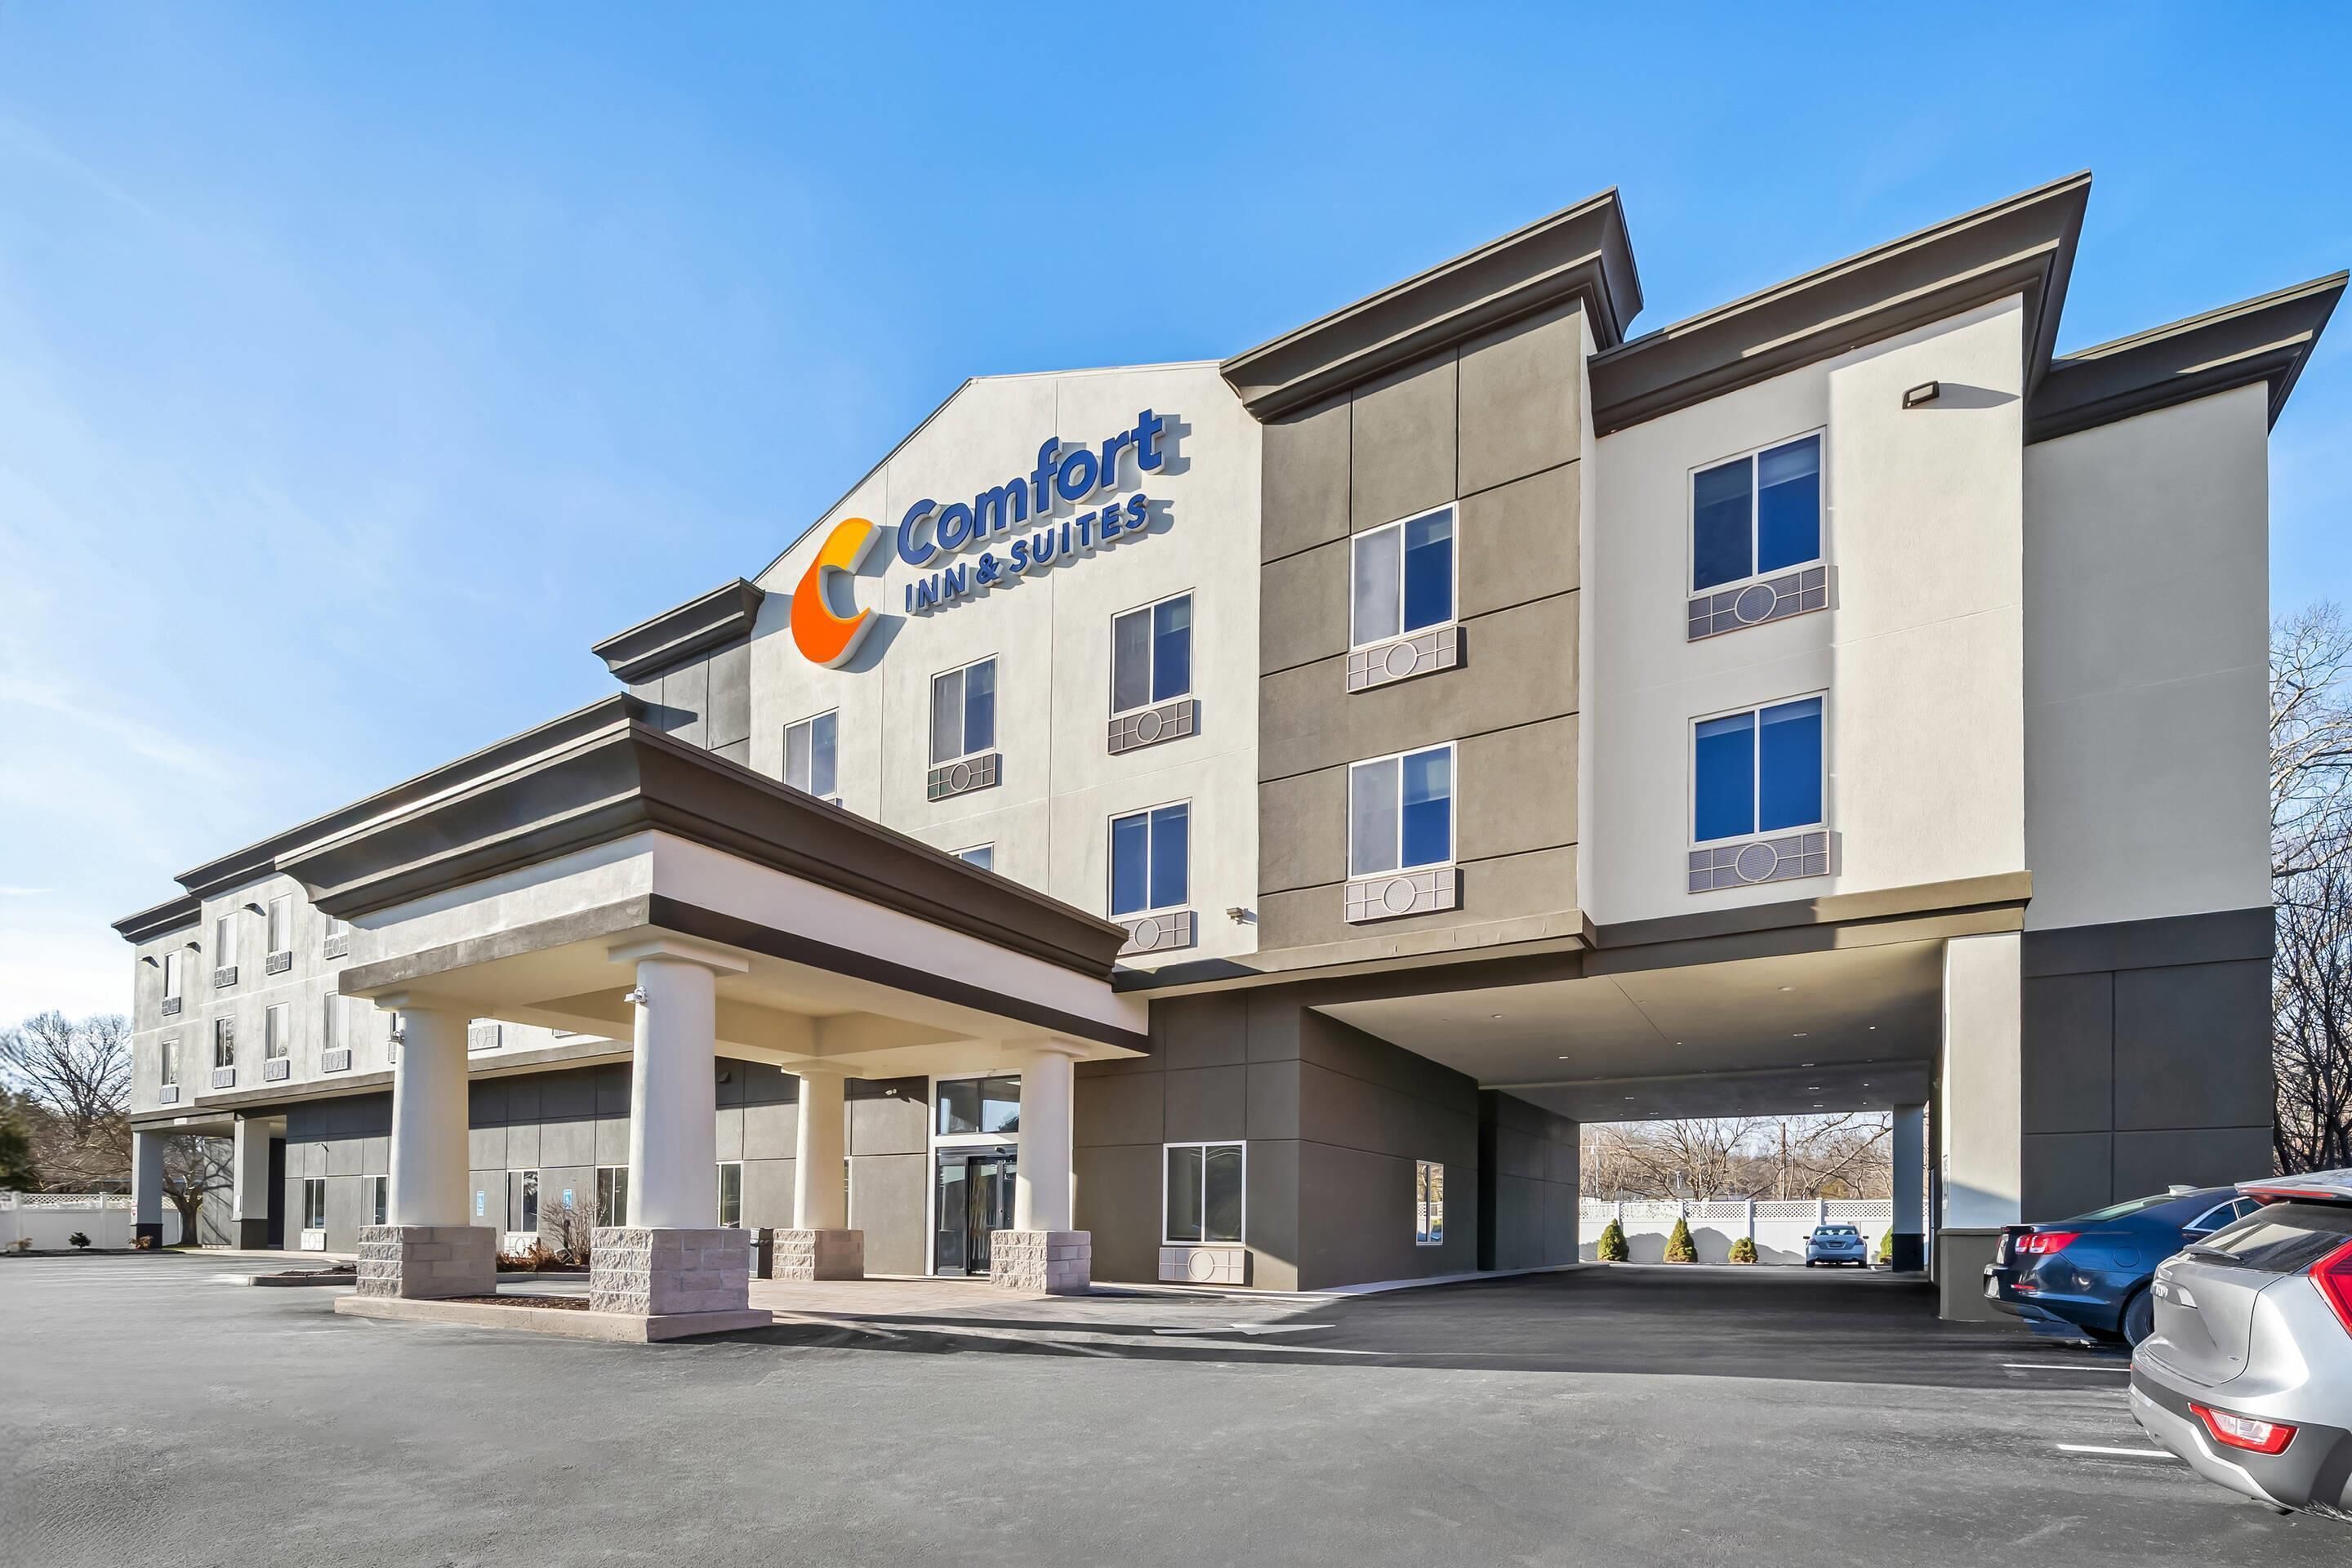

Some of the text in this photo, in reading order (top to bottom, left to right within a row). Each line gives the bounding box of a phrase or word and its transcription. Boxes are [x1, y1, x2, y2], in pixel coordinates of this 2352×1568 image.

[896, 407, 1165, 567] Comfort
[905, 492, 1148, 613] INN & SUITES
